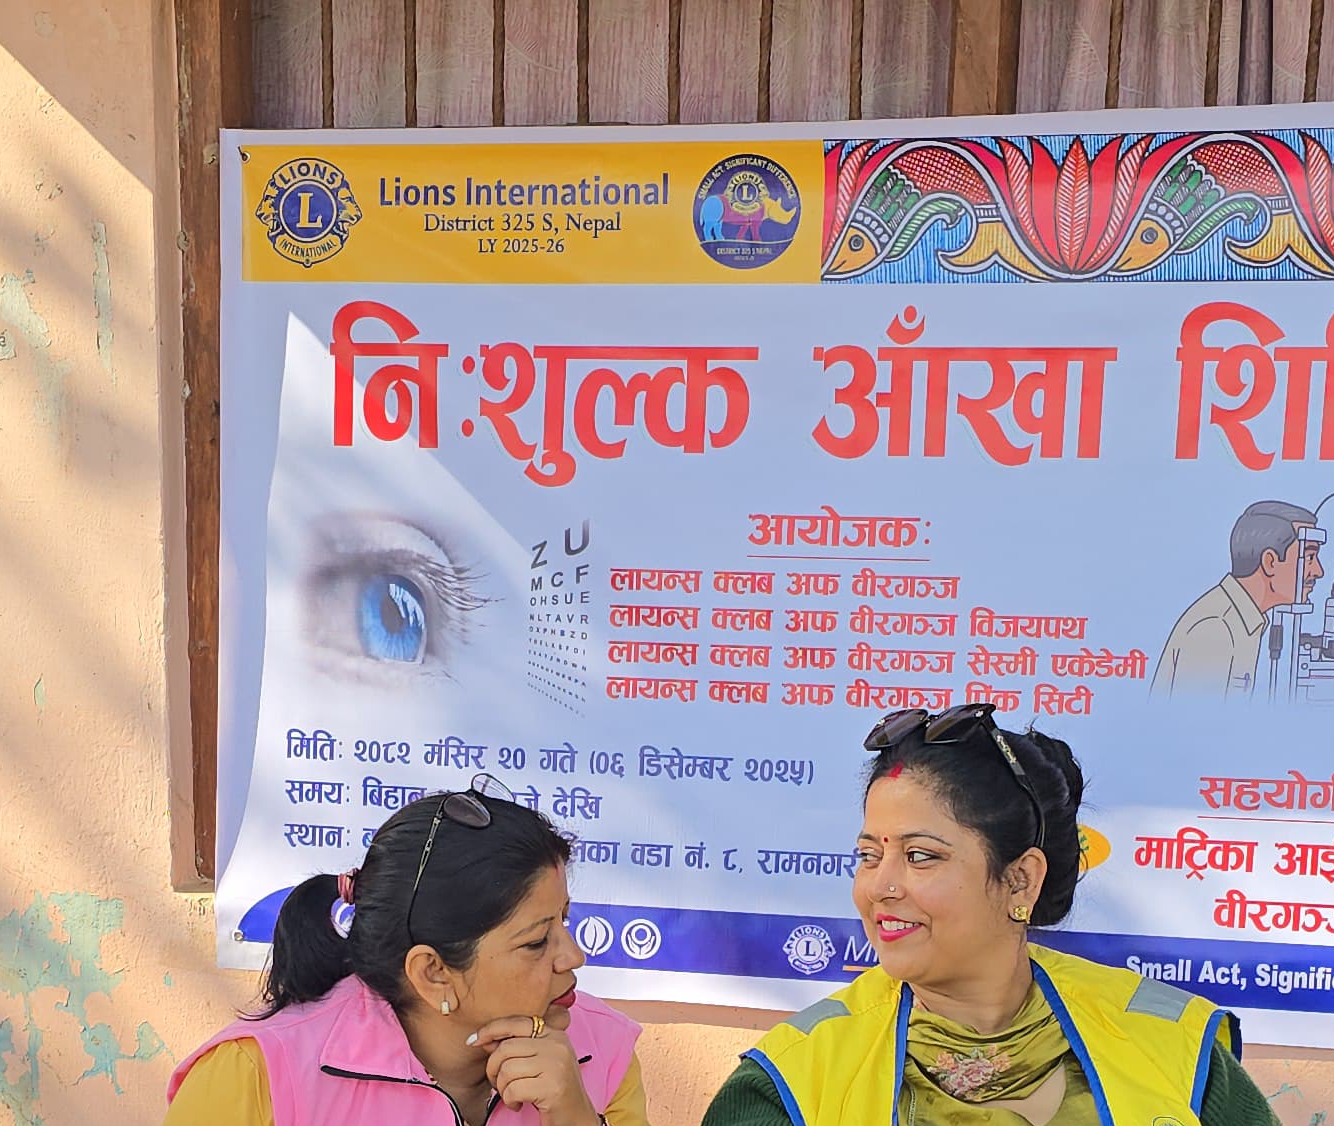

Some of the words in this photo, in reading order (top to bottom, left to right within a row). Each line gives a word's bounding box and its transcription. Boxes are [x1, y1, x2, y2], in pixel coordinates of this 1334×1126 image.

[279, 163, 338, 185] LIONS
[379, 177, 456, 206] Lions
[467, 172, 669, 206] International
[296, 192, 322, 228] L
[424, 214, 494, 232] District
[502, 213, 535, 231] 325
[542, 213, 559, 236] S,
[566, 211, 621, 238] Nepal
[280, 239, 337, 257] INTERNATIONAL
[478, 239, 496, 253] LY
[502, 238, 565, 253] 2025-26
[812, 304, 1118, 466] आँखा
[610, 568, 703, 593] लायन्स
[713, 571, 775, 595] क्लब
[786, 572, 841, 596] अफ
[852, 567, 960, 599] वीरगञ्ज
[609, 604, 701, 630] लायन्स
[712, 608, 773, 631] क्लब
[785, 610, 839, 632] अफ
[849, 604, 958, 636] वीरगञ्ज
[969, 607, 1088, 639] विजयपथ
[608, 641, 699, 666] लायन्स
[710, 644, 772, 668] क्लब
[784, 646, 837, 669] अफ
[848, 642, 955, 673] वीरगञ्ज
[1051, 648, 1148, 679] एकेडेमी
[606, 676, 698, 702] लायन्स
[709, 680, 770, 704] क्लब
[781, 683, 835, 706] अफ
[1034, 683, 1094, 715] सिटी
[354, 740, 411, 764] २०८२
[424, 736, 488, 769] मंसिर
[498, 747, 525, 770] २०
[539, 742, 578, 773] गते
[589, 750, 625, 778] (०६
[638, 745, 734, 781] डिसेम्बर
[744, 757, 814, 786] २०२५)
[552, 787, 602, 820] देखि
[631, 842, 673, 867] वडा
[1134, 826, 1258, 881] माट्रिका
[795, 926, 825, 938] LIONS
[804, 941, 816, 956] L
[1126, 956, 1191, 983] Small
[1199, 959, 1247, 990] Act,
